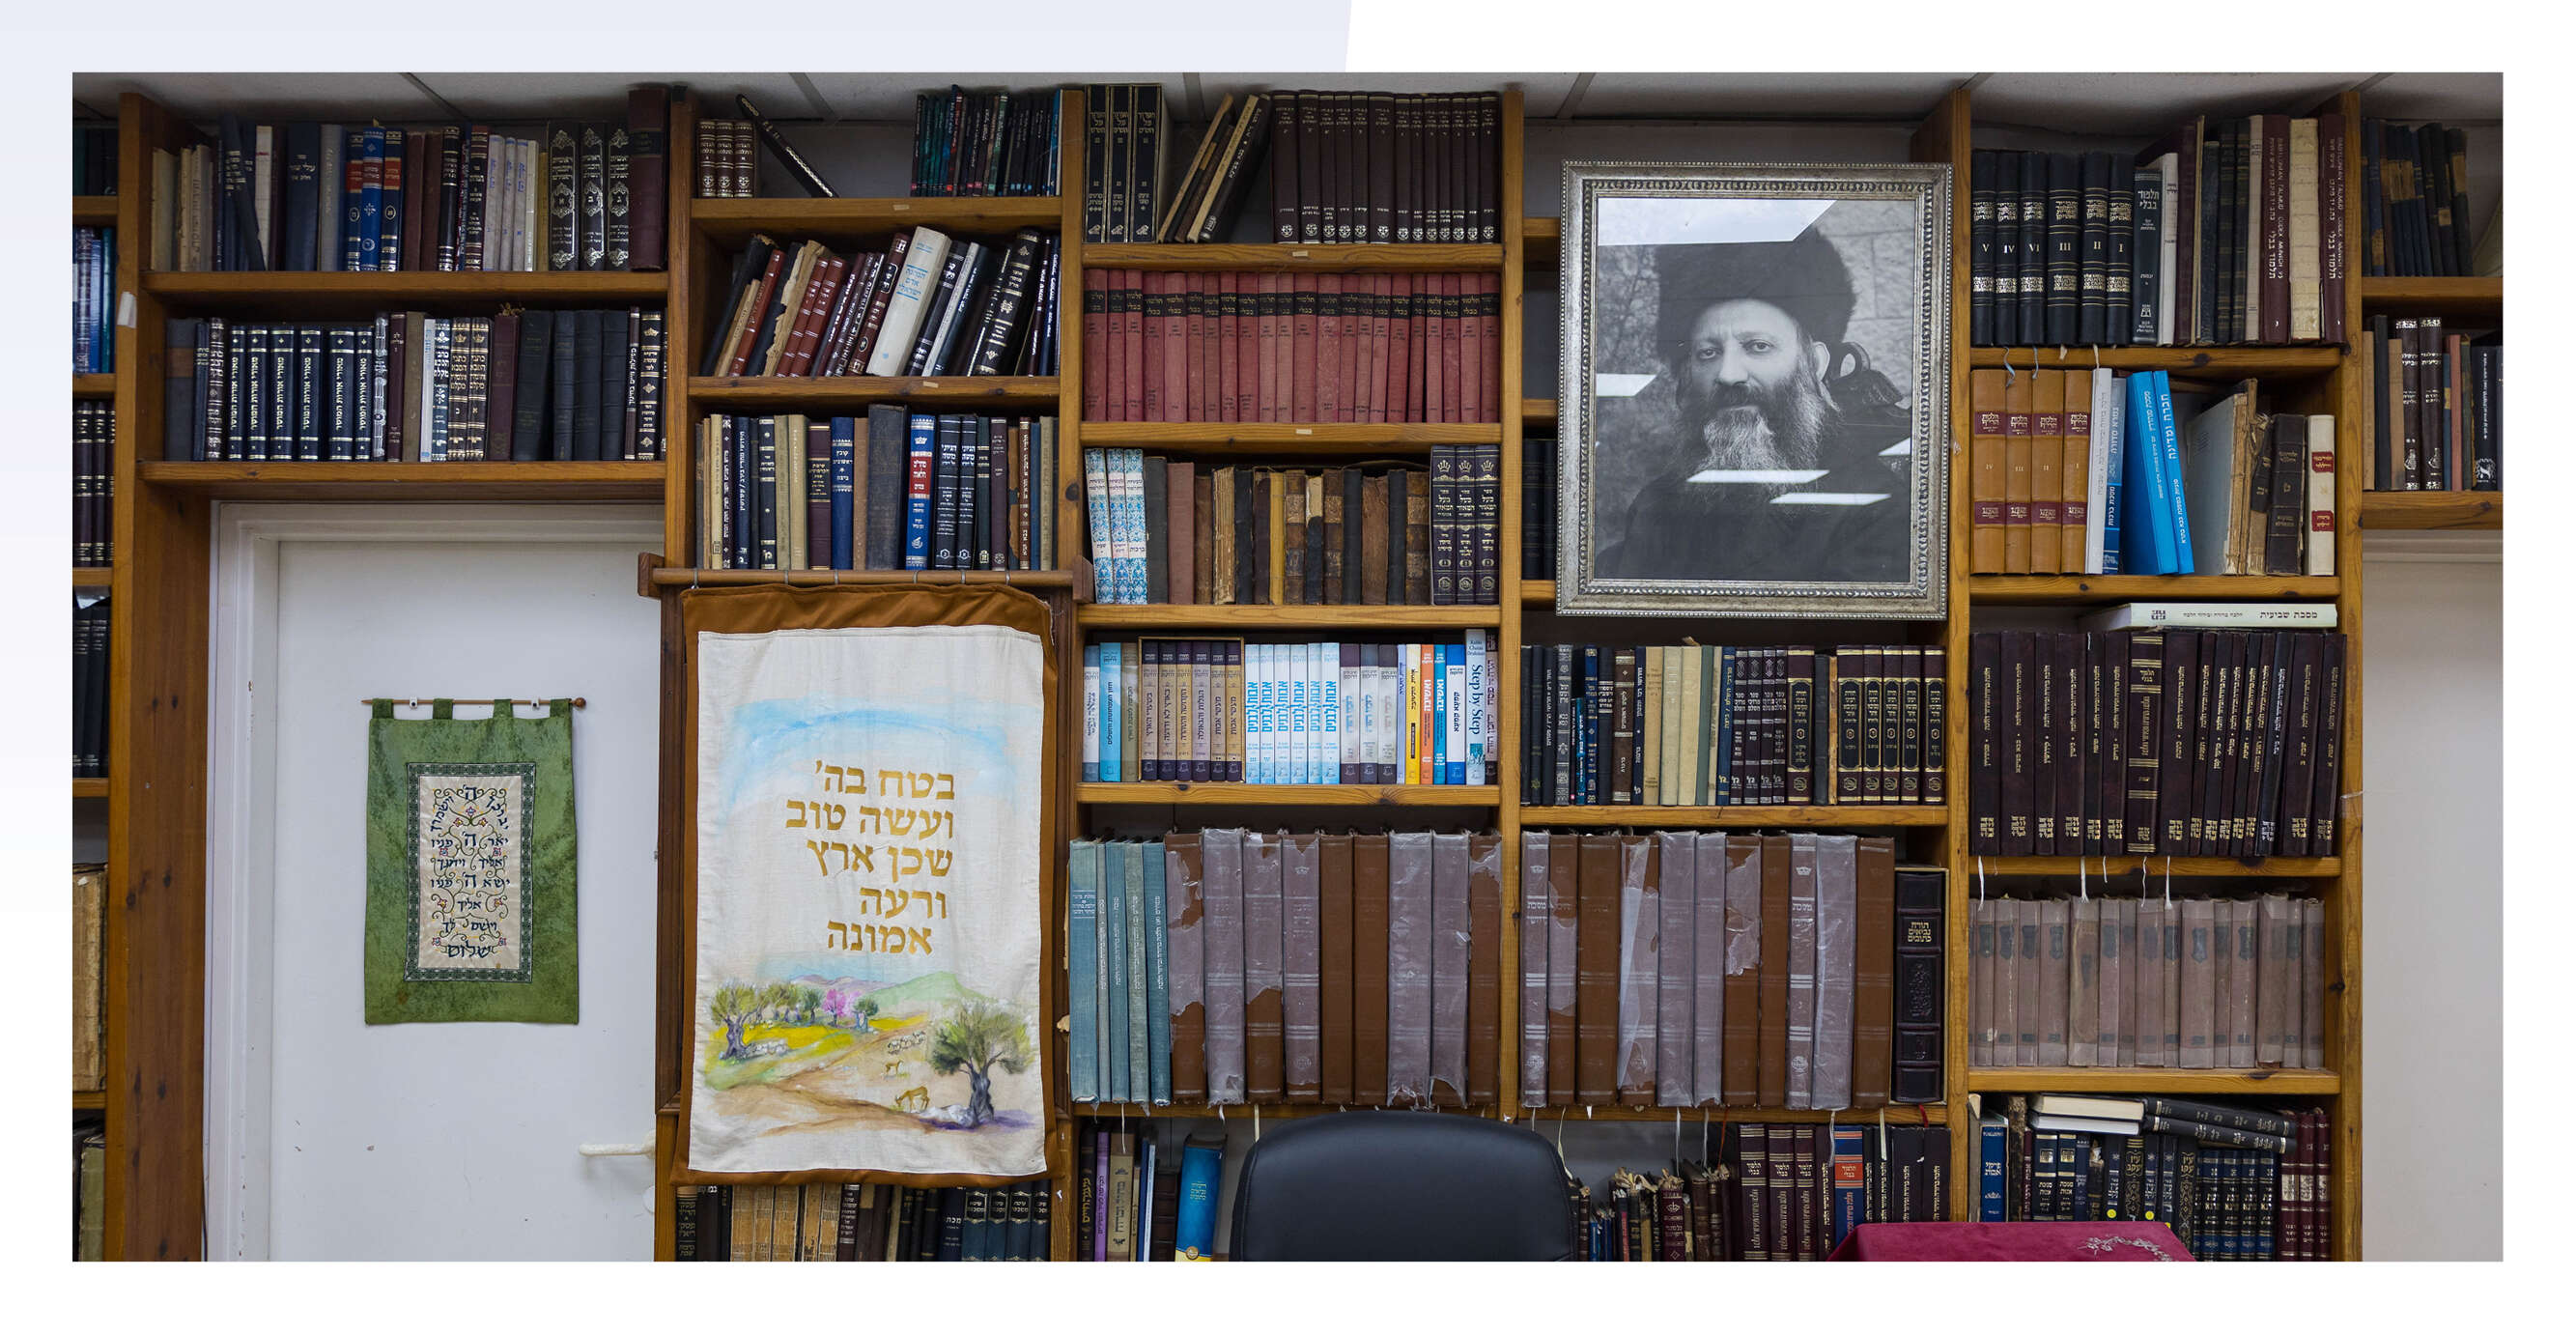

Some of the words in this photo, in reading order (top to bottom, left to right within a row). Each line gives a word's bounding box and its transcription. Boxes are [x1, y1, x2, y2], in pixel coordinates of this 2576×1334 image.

[2137, 190, 2159, 200] תלמוד
[2139, 201, 2157, 210] בבלי
[2003, 244, 2015, 254] IV
[2028, 243, 2040, 253] VI
[2059, 241, 2071, 251] III
[2093, 241, 2101, 250] II
[2118, 243, 2123, 252] I
[2160, 393, 2171, 421] חברה
[2165, 426, 2177, 460] ומדינה
[1469, 664, 1484, 691] Step
[1248, 681, 1259, 703] אבות
[1261, 681, 1272, 703] אבות
[1278, 681, 1288, 703] אבות
[1294, 681, 1305, 703] אבות
[1310, 681, 1320, 703] אבות
[1325, 681, 1337, 703] אבות
[1469, 693, 1484, 705] by
[1469, 707, 1484, 735] Step
[816, 759, 866, 796] בה'
[879, 770, 955, 801] בטח
[431, 795, 454, 832] וישמרך
[786, 799, 845, 831] טוב
[860, 807, 954, 839] ועשה
[431, 838, 453, 848] פניו
[488, 837, 508, 846] יאר
[437, 858, 466, 869] ויחנך
[478, 857, 502, 868] אליך
[807, 839, 874, 875] ארץ
[886, 845, 953, 877] שכן
[431, 878, 453, 888] פניו
[483, 878, 510, 887] ישא
[458, 898, 481, 911] אליך
[860, 886, 947, 920] ורעה
[442, 920, 456, 932] לך
[470, 922, 497, 931] וישם
[827, 921, 932, 955] אמונה
[447, 940, 491, 958] שלום
[2125, 1163, 2142, 1175] יעקב
